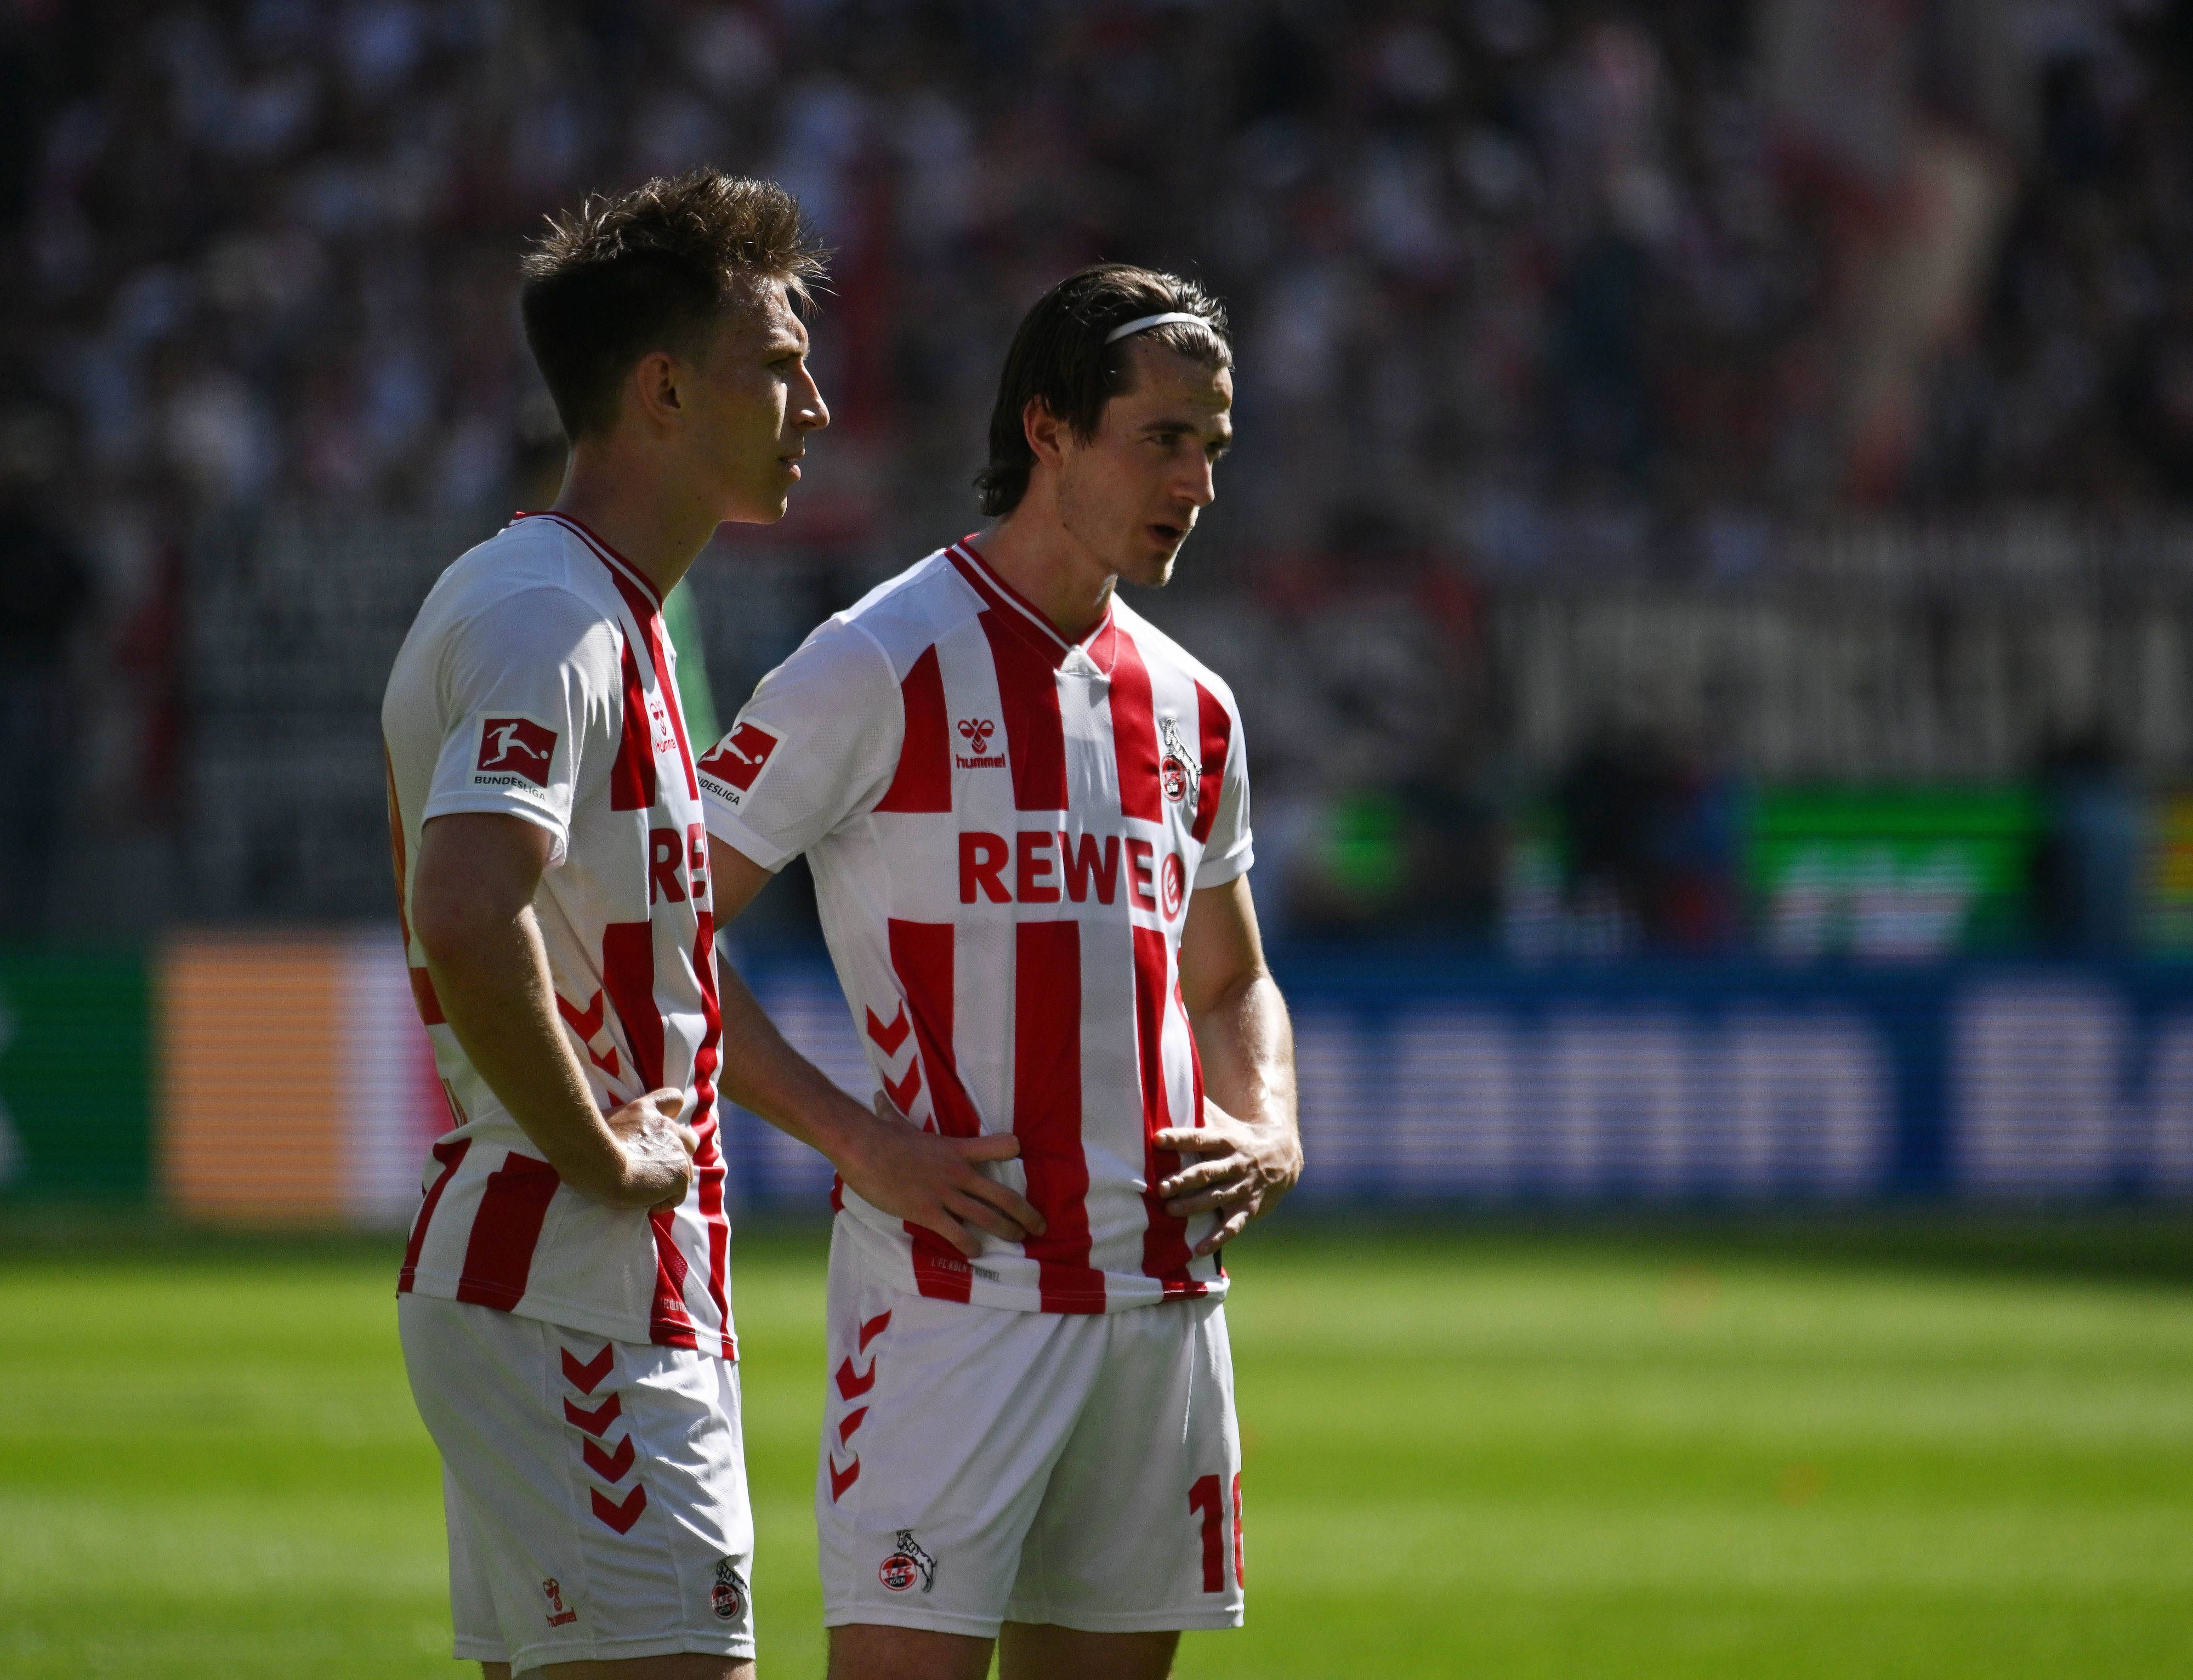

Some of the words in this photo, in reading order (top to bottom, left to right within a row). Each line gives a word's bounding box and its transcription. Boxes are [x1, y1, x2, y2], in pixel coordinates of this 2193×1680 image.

[956, 753, 1006, 769] hummel
[474, 776, 546, 802] BUNDESLIGA
[959, 831, 1156, 912] REWE
